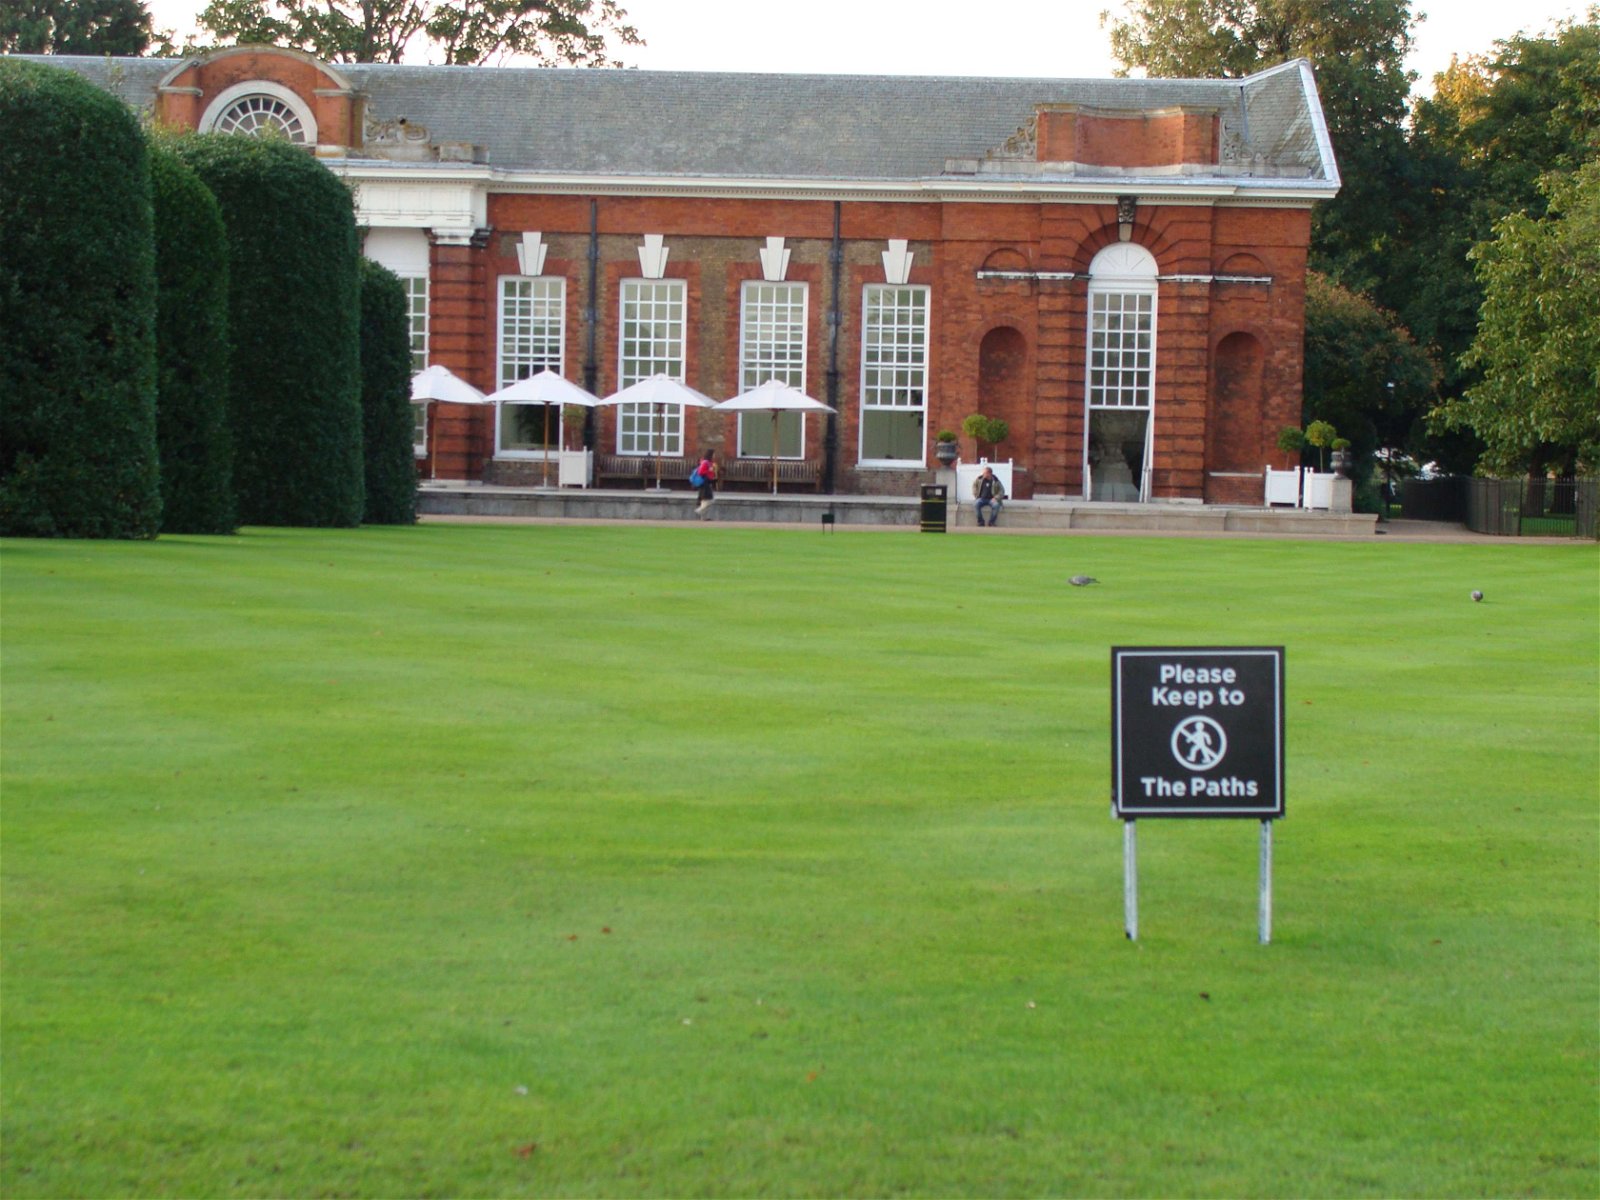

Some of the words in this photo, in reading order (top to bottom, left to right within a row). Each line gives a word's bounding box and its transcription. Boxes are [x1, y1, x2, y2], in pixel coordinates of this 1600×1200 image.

[1160, 663, 1237, 684] Please
[1151, 686, 1214, 709] Keep
[1218, 686, 1245, 706] to
[1140, 776, 1187, 797] The
[1190, 776, 1259, 797] Paths
